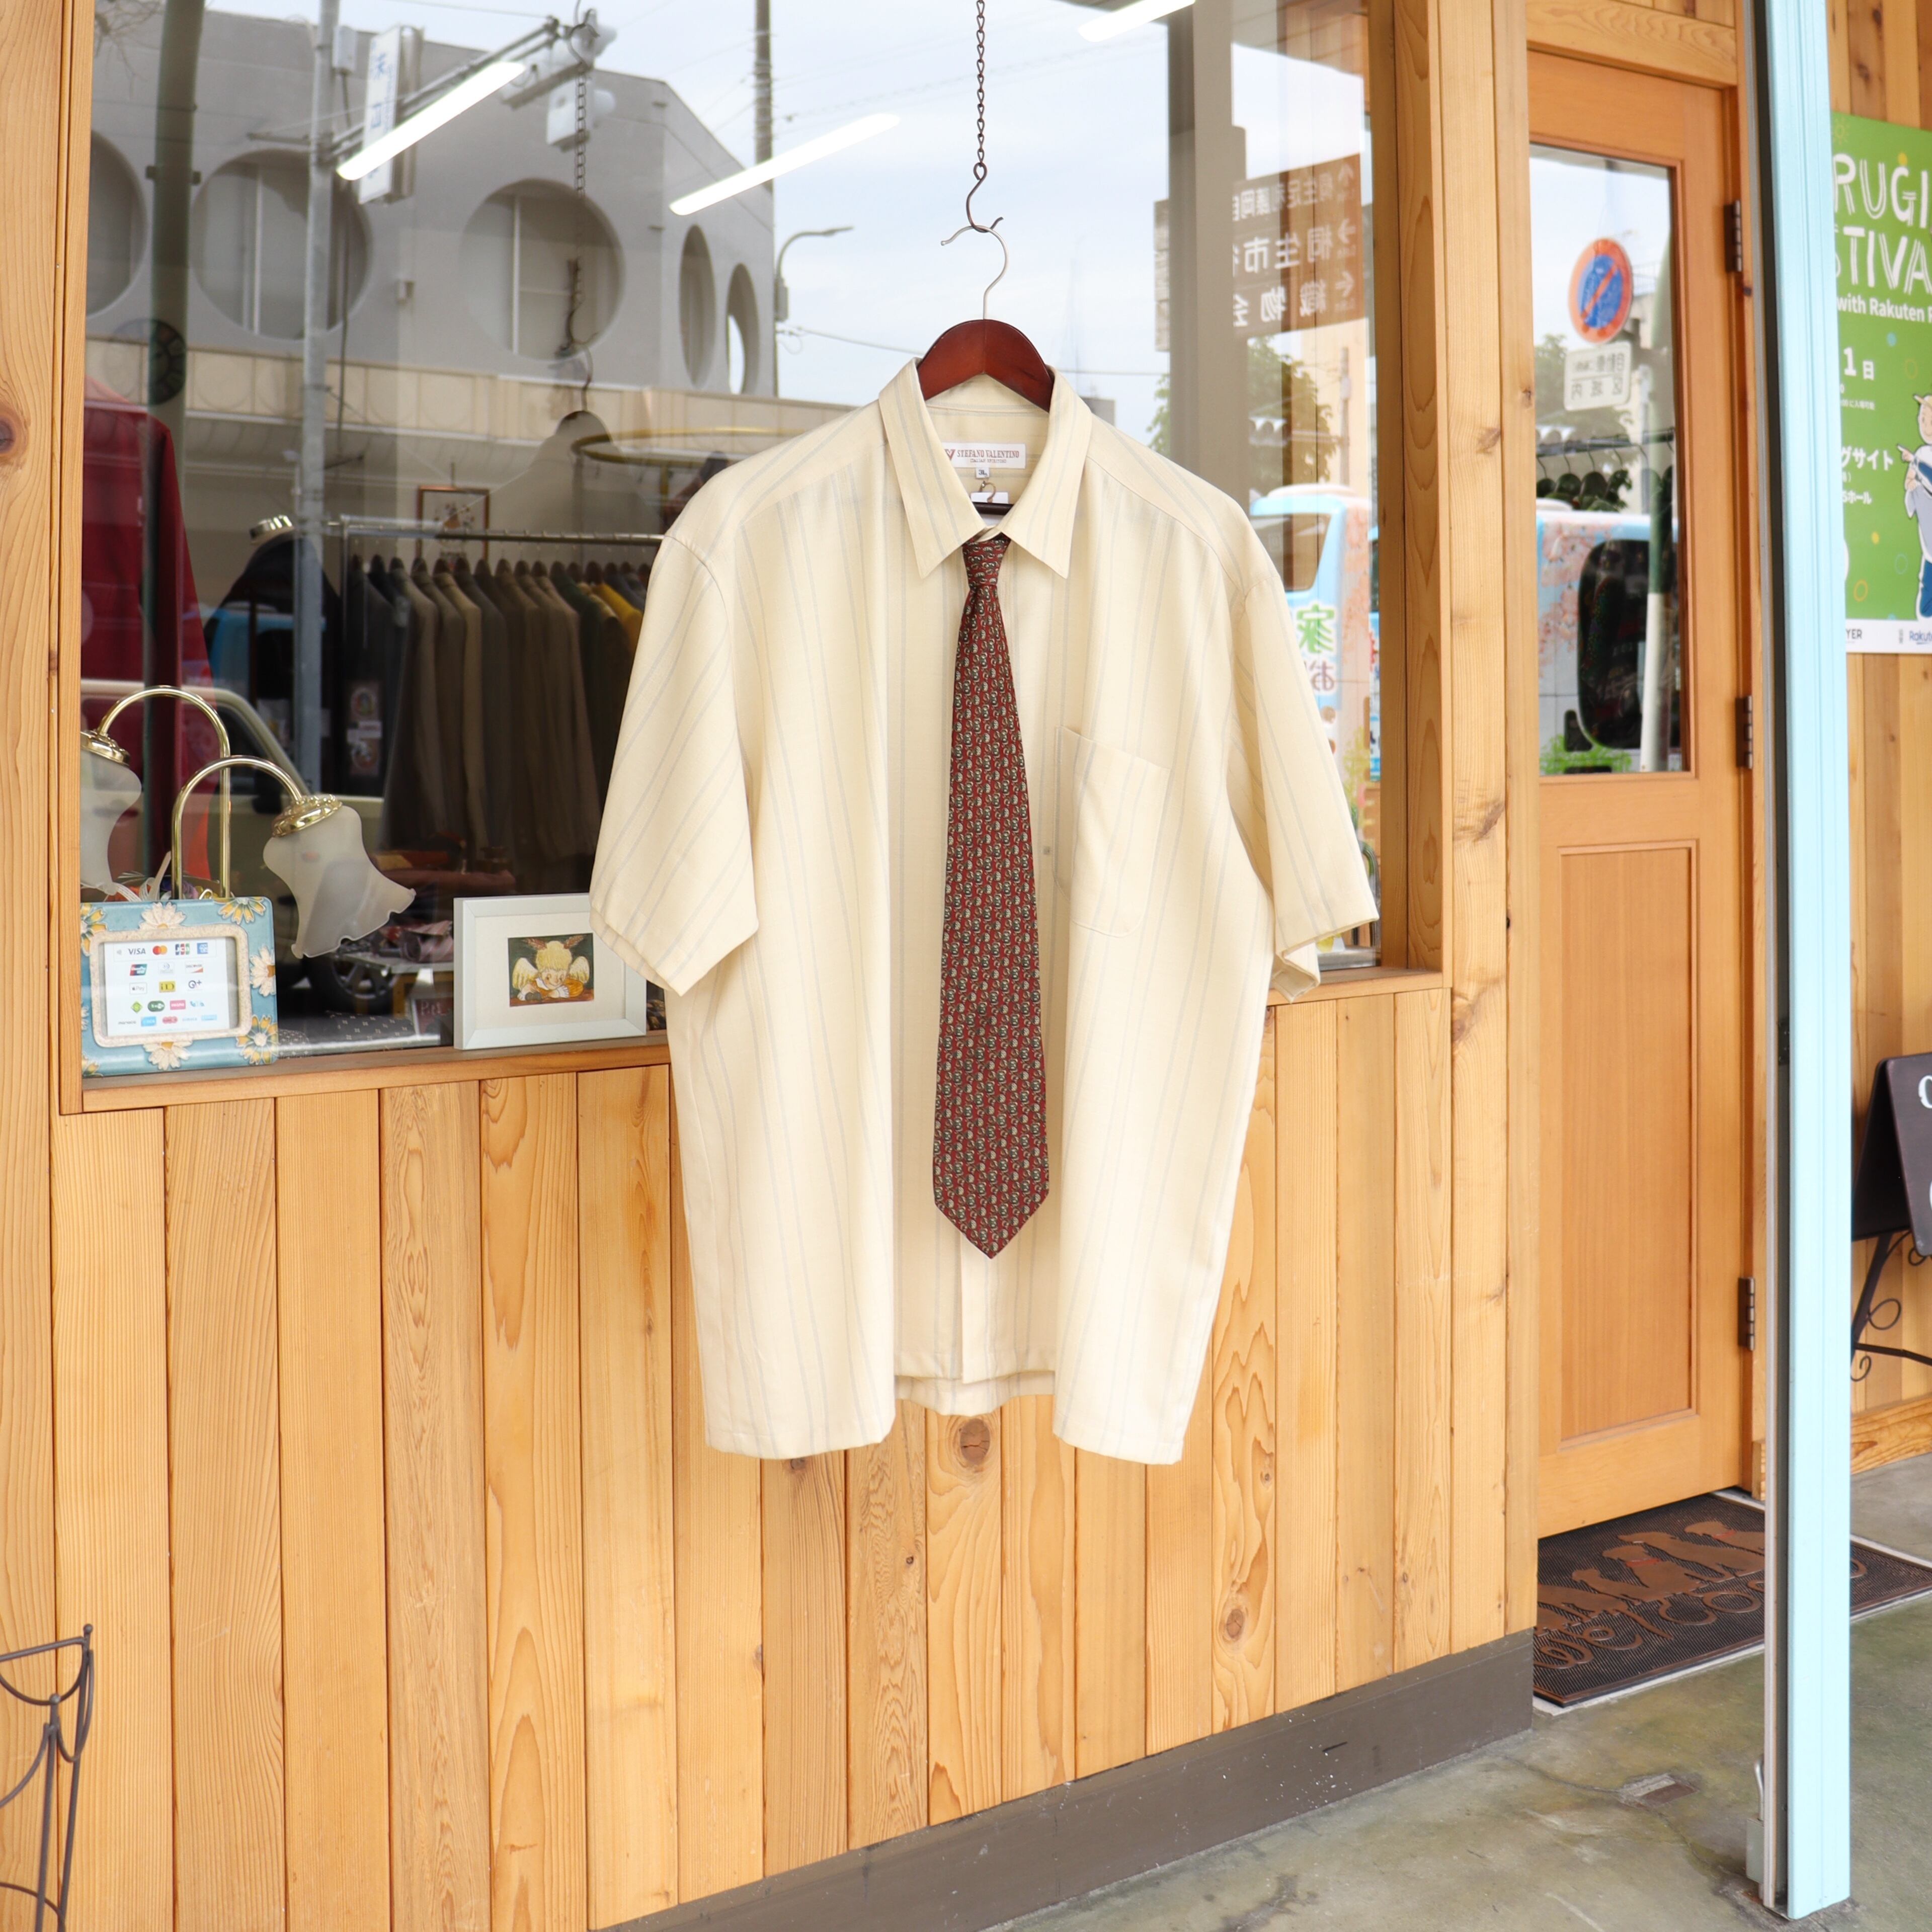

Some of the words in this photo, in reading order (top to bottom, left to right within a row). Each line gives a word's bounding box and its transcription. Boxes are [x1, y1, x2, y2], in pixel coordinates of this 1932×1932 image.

[1834, 226, 1932, 295] TIVA
[1837, 293, 1866, 314] with
[1869, 297, 1925, 323] Rakuten
[957, 449, 985, 458] STEFANO
[986, 450, 1020, 458] VALENTINO
